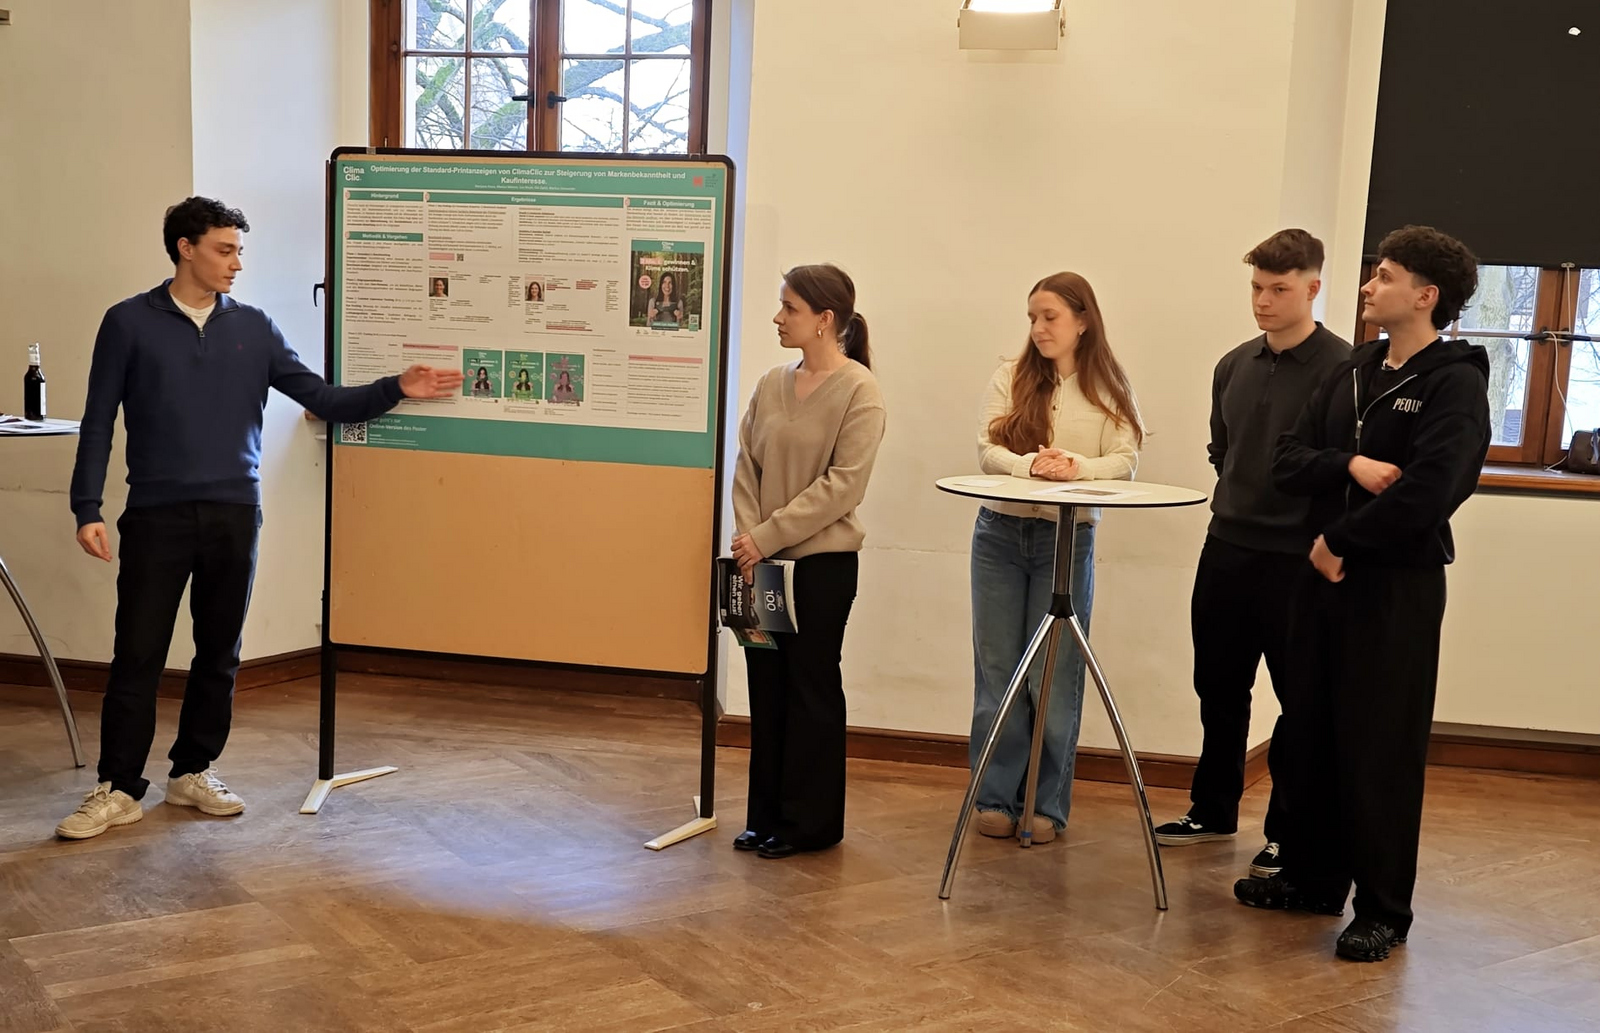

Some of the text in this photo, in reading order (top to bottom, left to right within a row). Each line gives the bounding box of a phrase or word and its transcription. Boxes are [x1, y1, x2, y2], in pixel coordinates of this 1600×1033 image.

[343, 166, 365, 174] Clima
[370, 165, 410, 174] Optimierung
[423, 166, 497, 176] Standard-Printanzeigen
[512, 168, 543, 176] ClimaClic
[556, 169, 592, 178] Steigerung
[608, 170, 671, 179] Markenbekanntheit
[501, 177, 548, 185] Kaufinteresse.
[765, 590, 776, 612] 100
